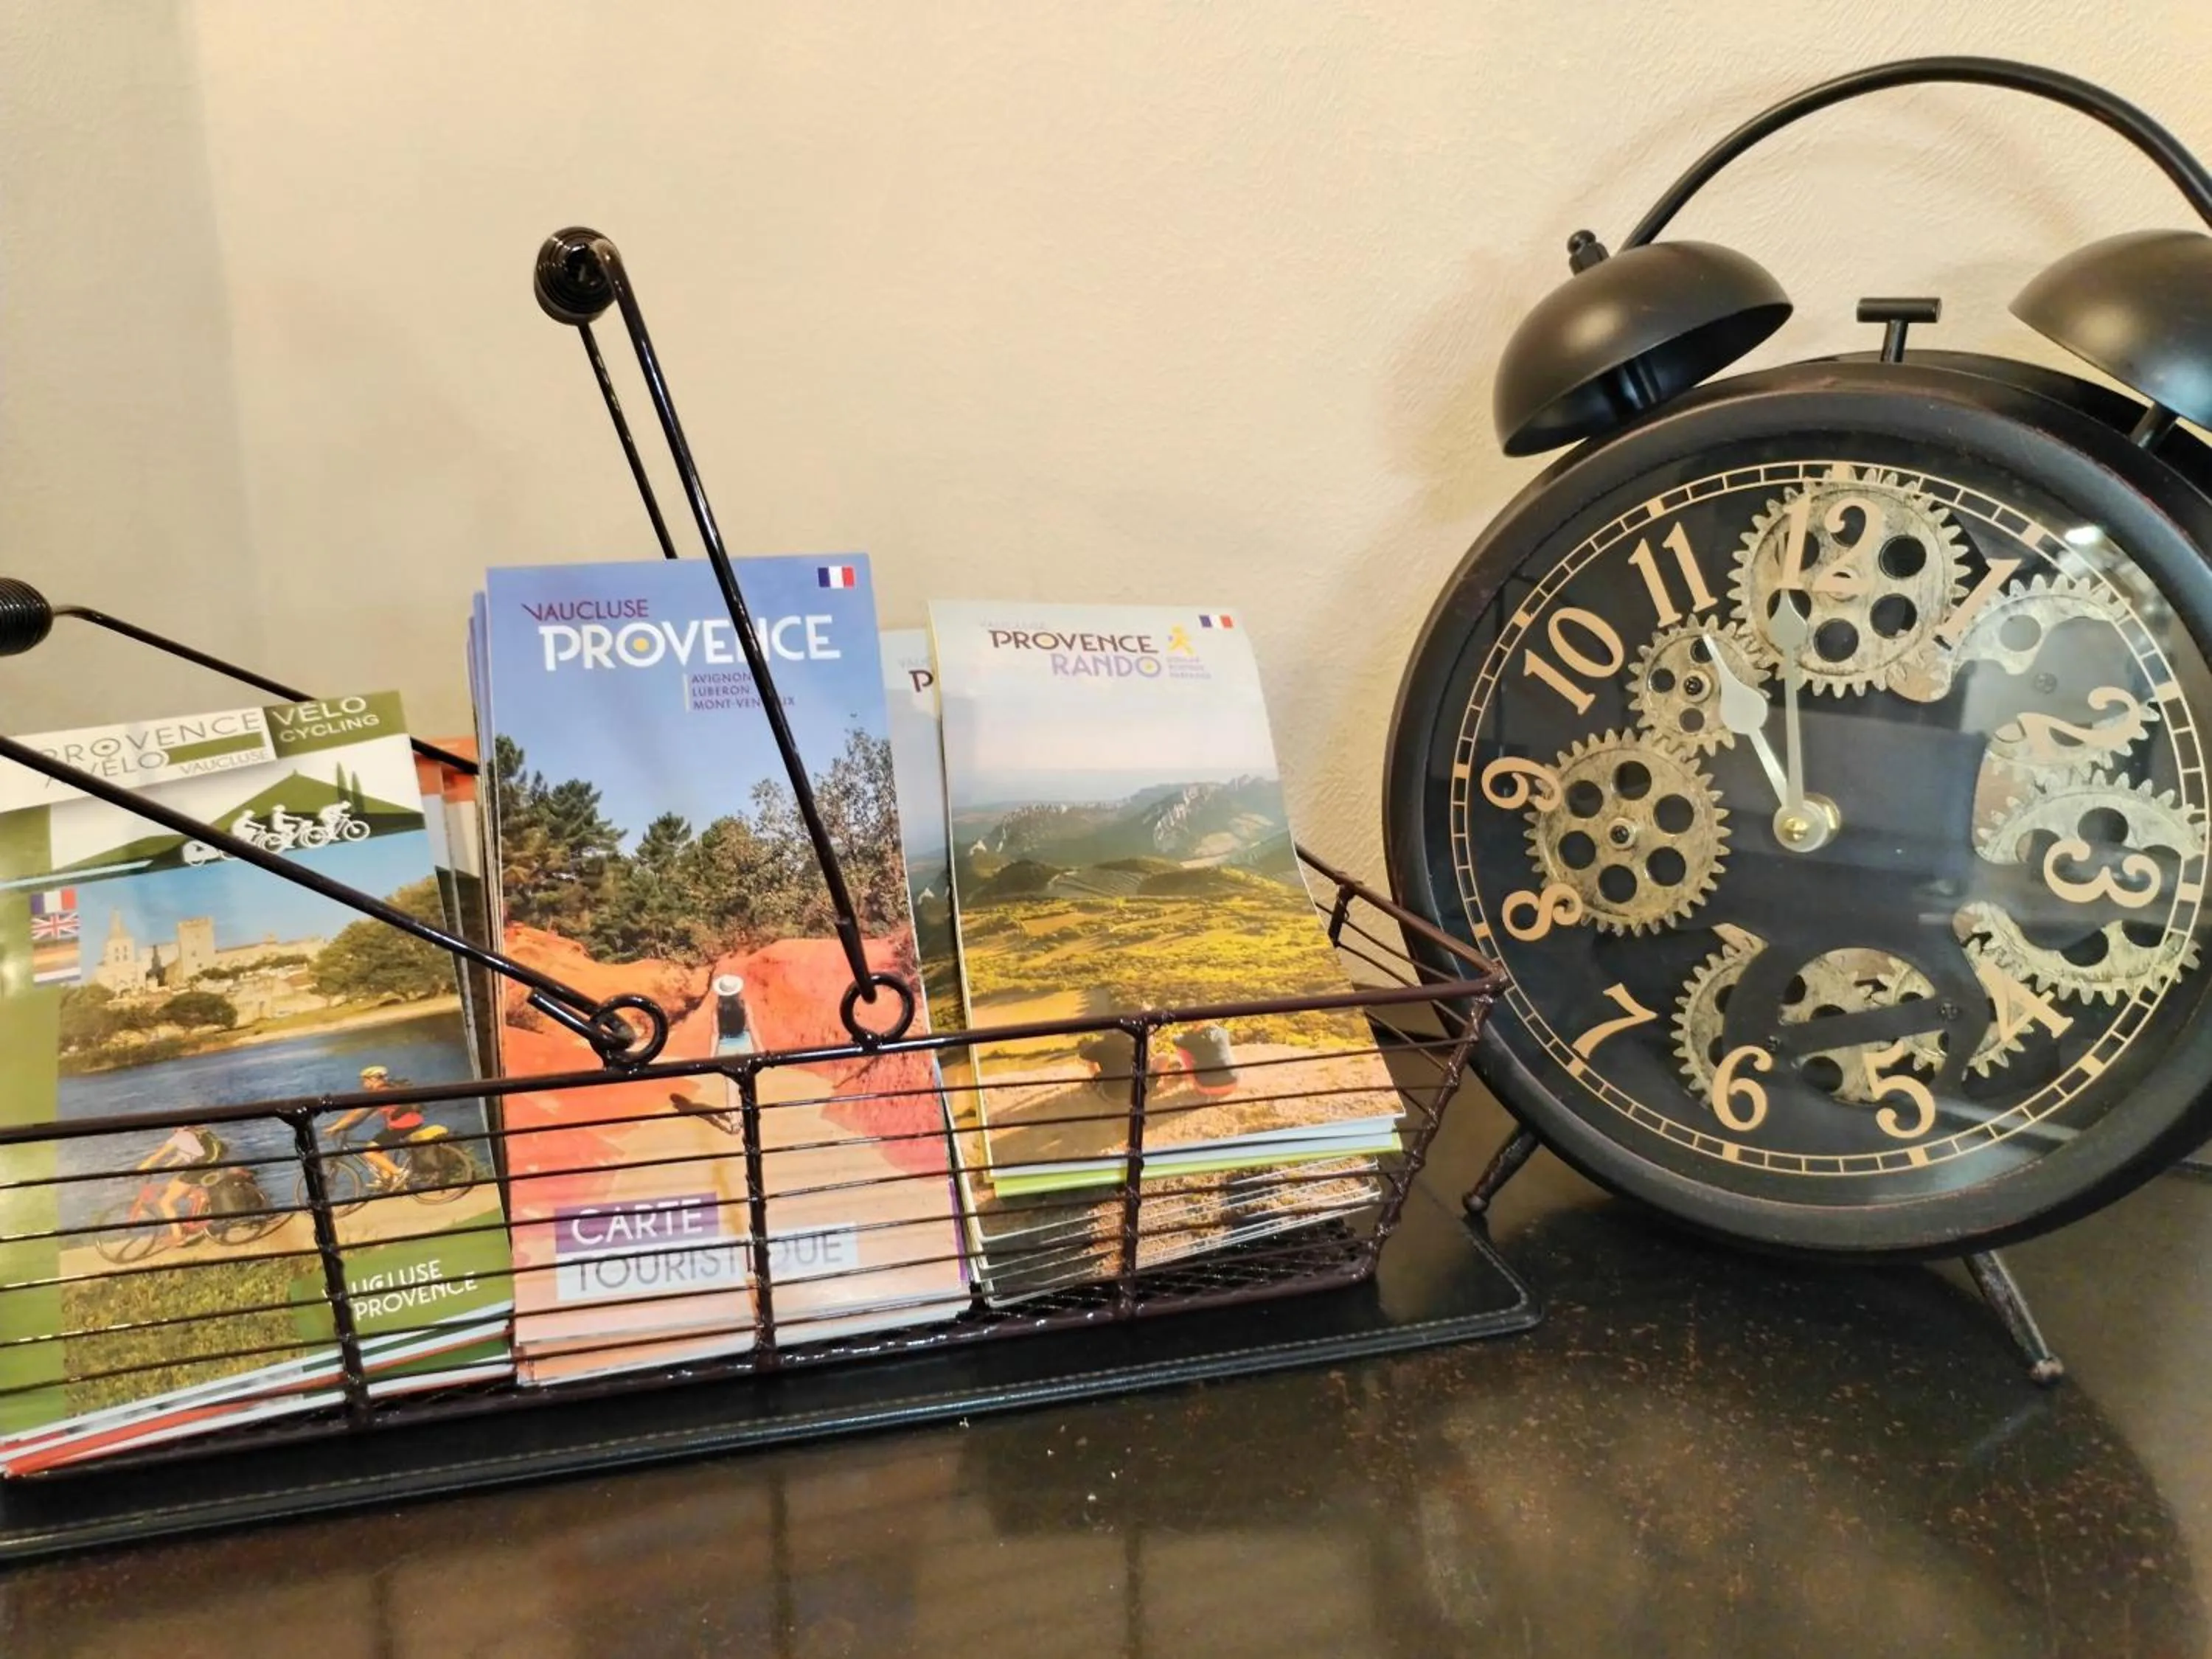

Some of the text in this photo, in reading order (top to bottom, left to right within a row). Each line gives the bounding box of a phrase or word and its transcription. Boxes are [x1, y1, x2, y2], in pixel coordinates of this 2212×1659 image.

[1779, 495, 1883, 595] 12
[1628, 522, 1719, 628] 11
[1933, 557, 2019, 641] 1
[521, 599, 649, 622] VAUCLUSE
[988, 629, 1159, 653] PROVENCE
[1051, 653, 1162, 678] RANDO
[1523, 606, 1624, 714] 10
[692, 671, 752, 684] AVIGNON
[692, 684, 750, 698] LUBERON
[279, 714, 380, 743] CYCLING
[1994, 687, 2141, 758] 2
[179, 748, 269, 774] VAUCLUSE
[1481, 757, 1562, 816] 9
[2042, 841, 2161, 909] 3
[1502, 884, 1585, 942] 8
[1573, 984, 1658, 1060] 7
[1972, 956, 2073, 1043] 4
[1712, 1045, 1773, 1132] 6
[1863, 1040, 1935, 1139] 5
[571, 1198, 703, 1245] CARTE
[352, 1270, 479, 1321] PROVENCE
